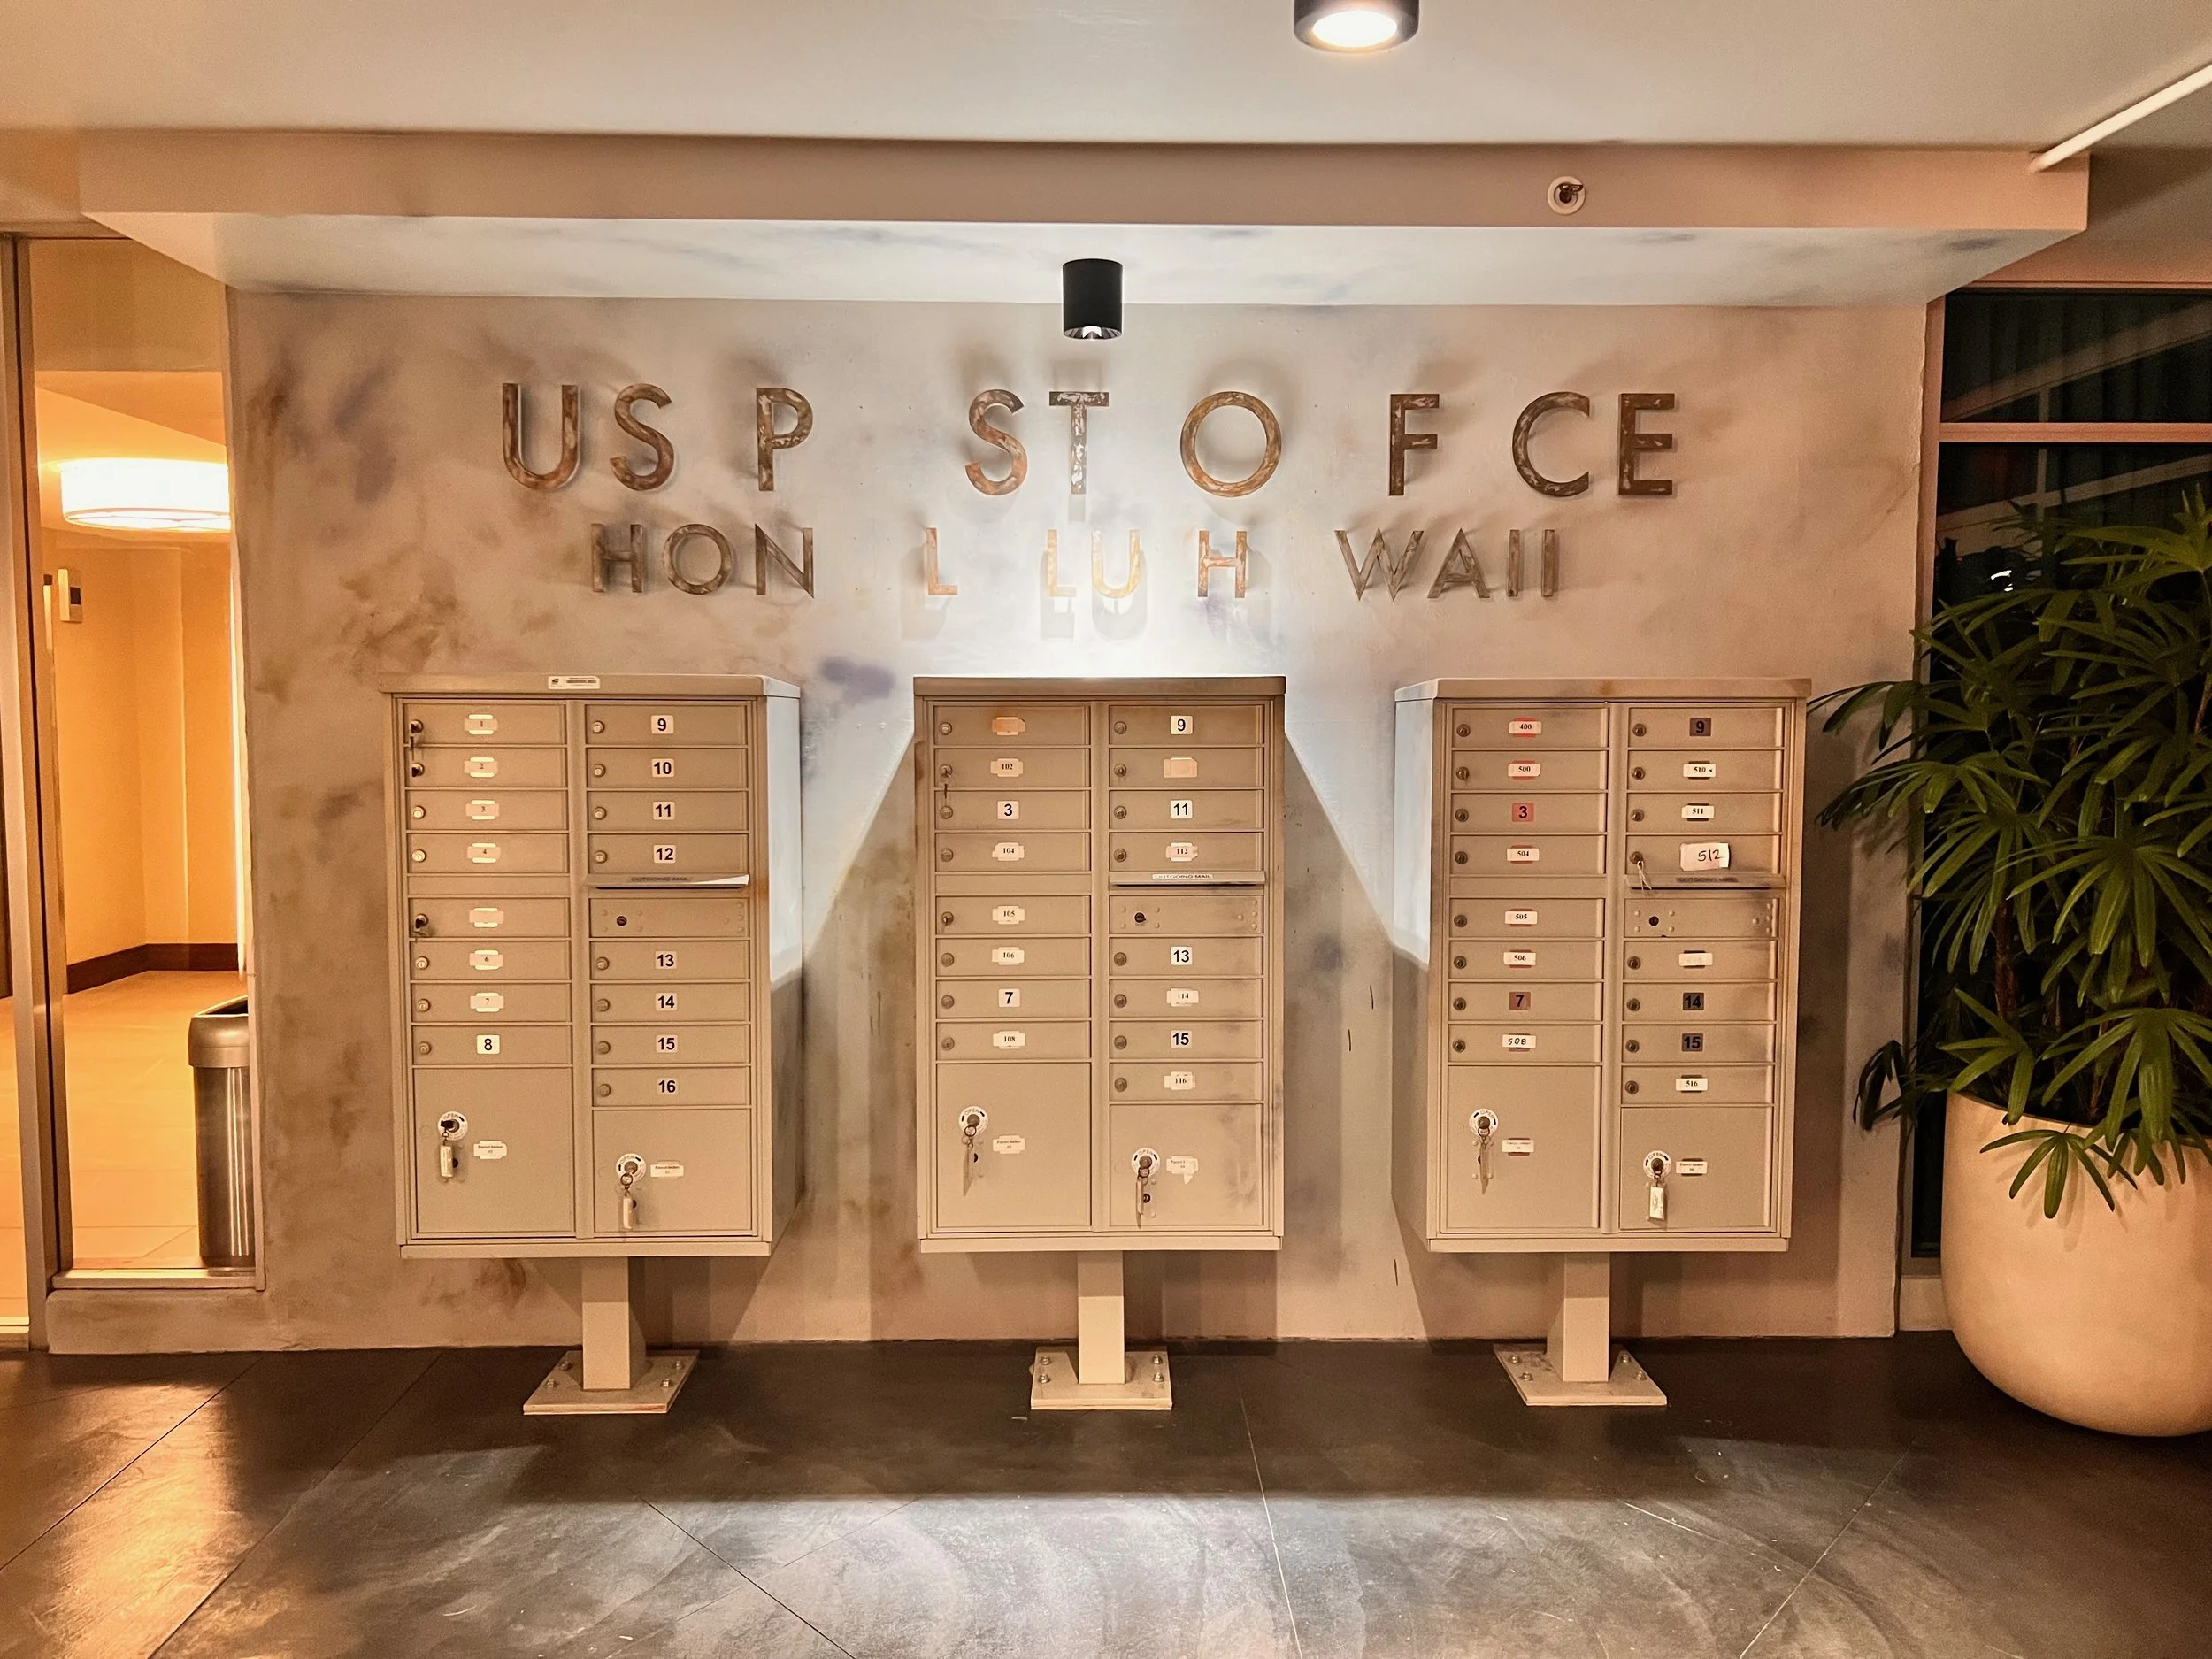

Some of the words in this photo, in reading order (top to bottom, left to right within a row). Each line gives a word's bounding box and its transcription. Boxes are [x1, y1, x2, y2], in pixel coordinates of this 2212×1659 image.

[1388, 394, 1440, 496] F
[590, 523, 815, 599] HON
[1334, 528, 1556, 602] WAII
[657, 718, 666, 731] 9
[1178, 719, 1186, 731] 9
[1696, 721, 1704, 733] 9
[654, 762, 671, 774] 10
[656, 804, 671, 817] 11
[1004, 804, 1012, 816] 3
[1174, 803, 1187, 815] 11
[1519, 806, 1527, 818] 3
[657, 848, 673, 860] 12
[1699, 849, 1720, 861] 512
[657, 955, 674, 966] 13
[1174, 950, 1189, 962] 13
[658, 995, 674, 1008] 14
[1005, 992, 1013, 1003] 7
[1516, 995, 1524, 1007] 7
[1685, 995, 1701, 1008] 14
[484, 1039, 492, 1050] 8
[658, 1038, 674, 1050] 15
[1173, 1033, 1189, 1045] 15
[1508, 1037, 1526, 1046] 508
[1684, 1037, 1700, 1048] 15
[659, 1080, 675, 1093] 16
[1479, 1110, 1494, 1119] OPEN
